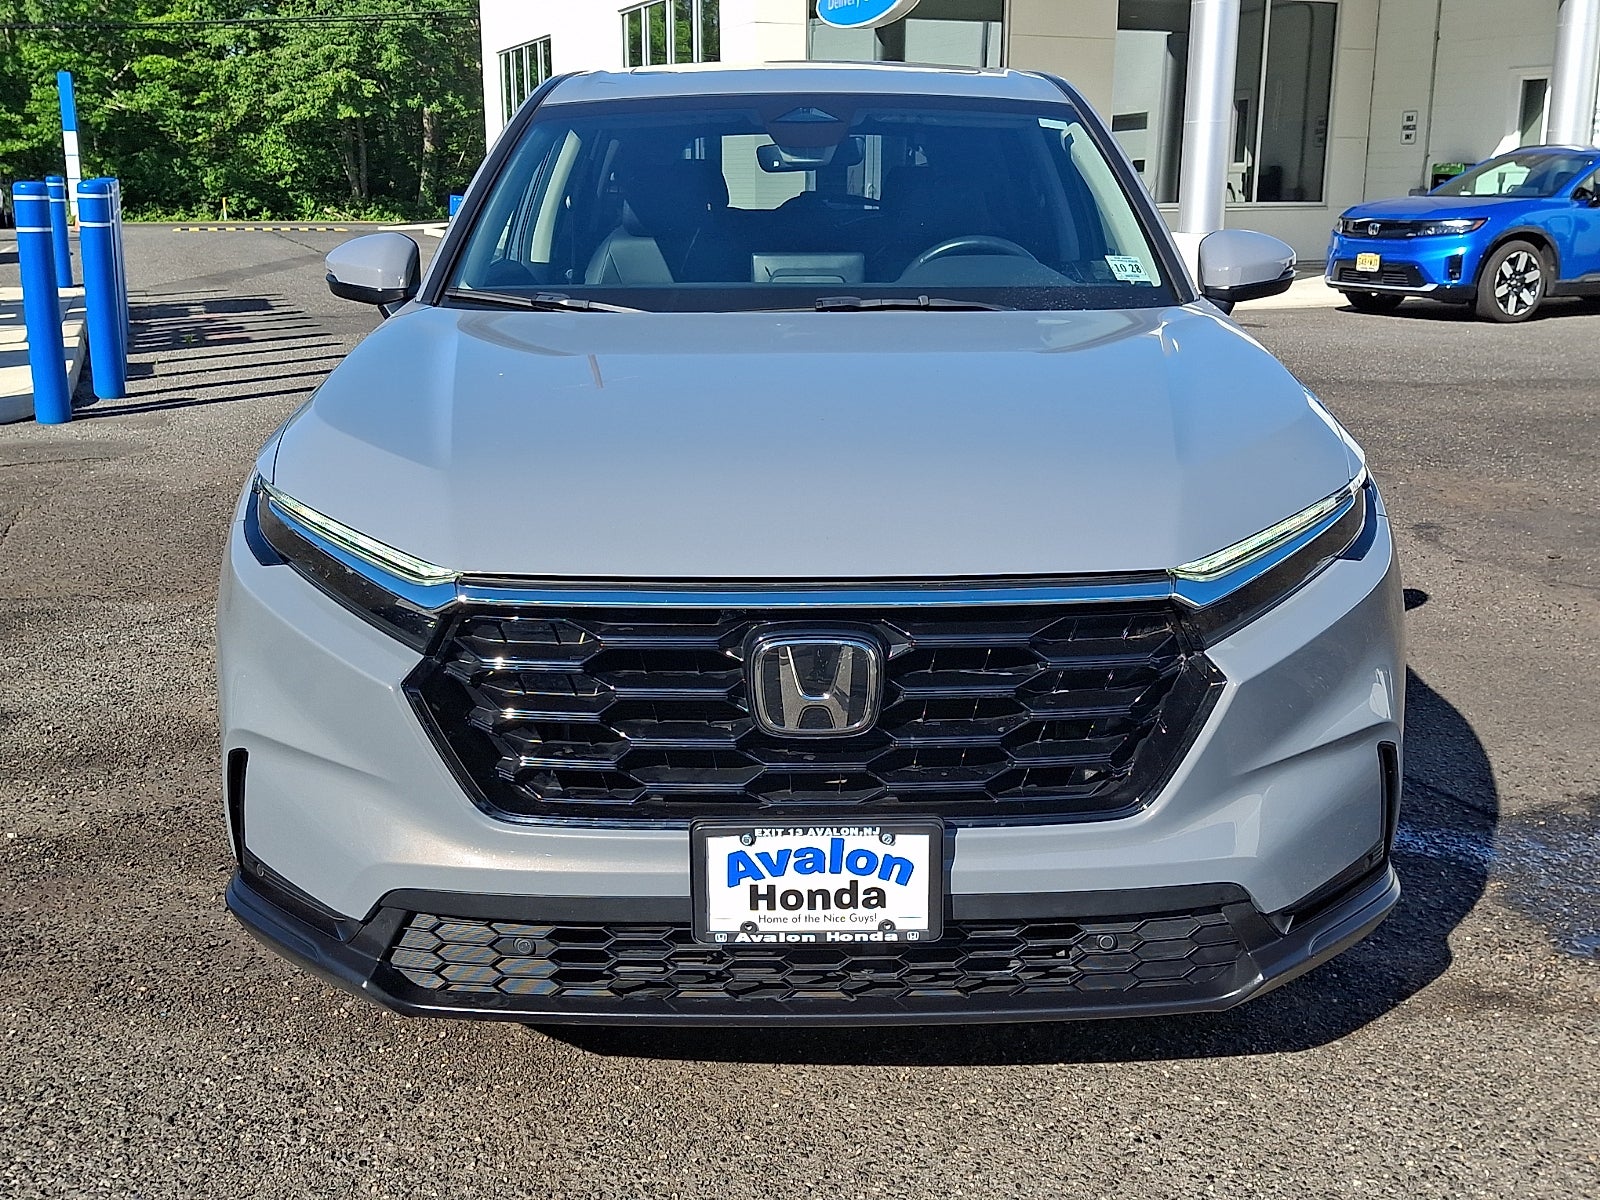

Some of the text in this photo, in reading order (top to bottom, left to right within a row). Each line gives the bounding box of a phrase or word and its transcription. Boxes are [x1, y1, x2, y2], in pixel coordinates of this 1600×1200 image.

[1114, 263, 1142, 273] 10 28
[754, 828, 785, 837] EXIT
[787, 828, 803, 837] 13
[727, 837, 915, 888] Avalon
[749, 880, 887, 911] Honda
[758, 912, 877, 925] Home of the Nice Guys!
[735, 931, 899, 943] Avalon Honda
